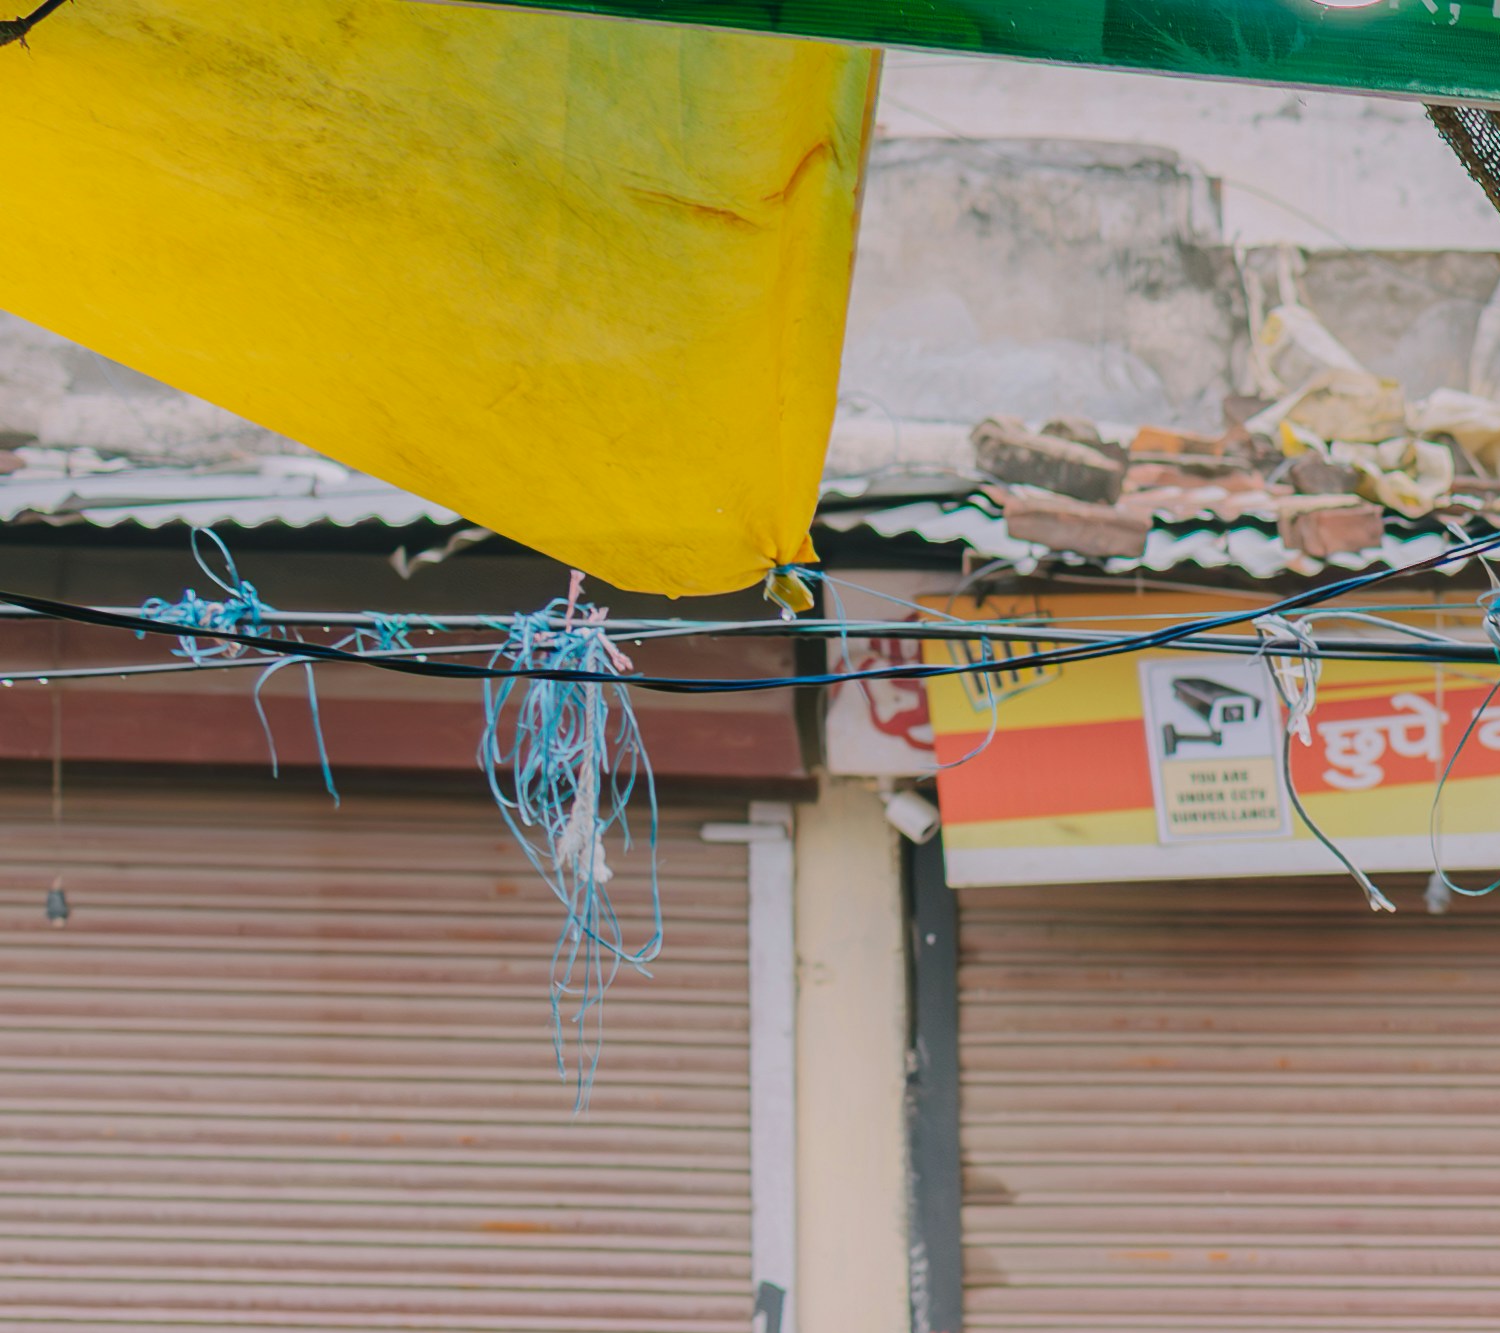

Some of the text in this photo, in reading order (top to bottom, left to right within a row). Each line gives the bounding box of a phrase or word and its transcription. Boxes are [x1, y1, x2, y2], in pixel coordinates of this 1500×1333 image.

[1316, 692, 1449, 791] छुपे
[1189, 769, 1249, 784] YOU ARE
[1176, 791, 1225, 804] UNDER
[1170, 808, 1277, 824] SURVEILLANCE
